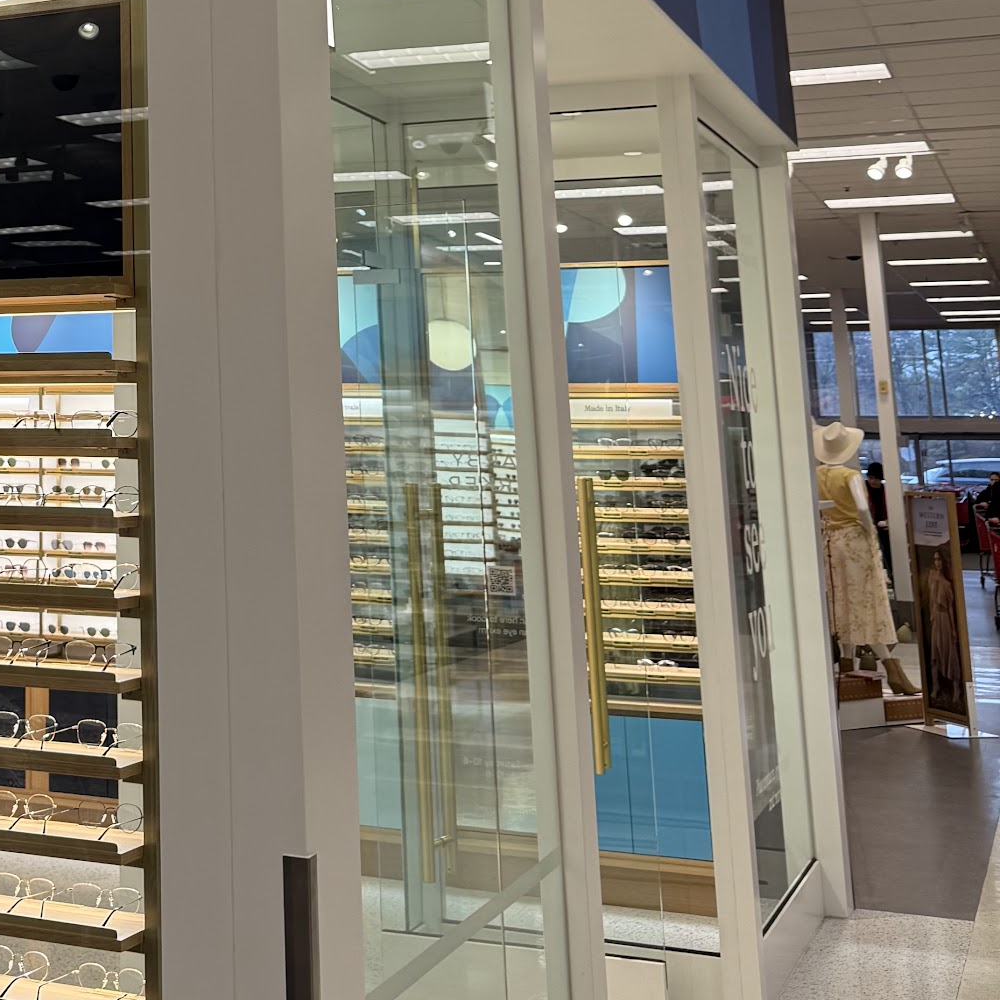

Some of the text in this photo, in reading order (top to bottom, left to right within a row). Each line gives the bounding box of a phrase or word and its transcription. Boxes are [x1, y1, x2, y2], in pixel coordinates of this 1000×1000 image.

[584, 404, 631, 413] Made in Italy
